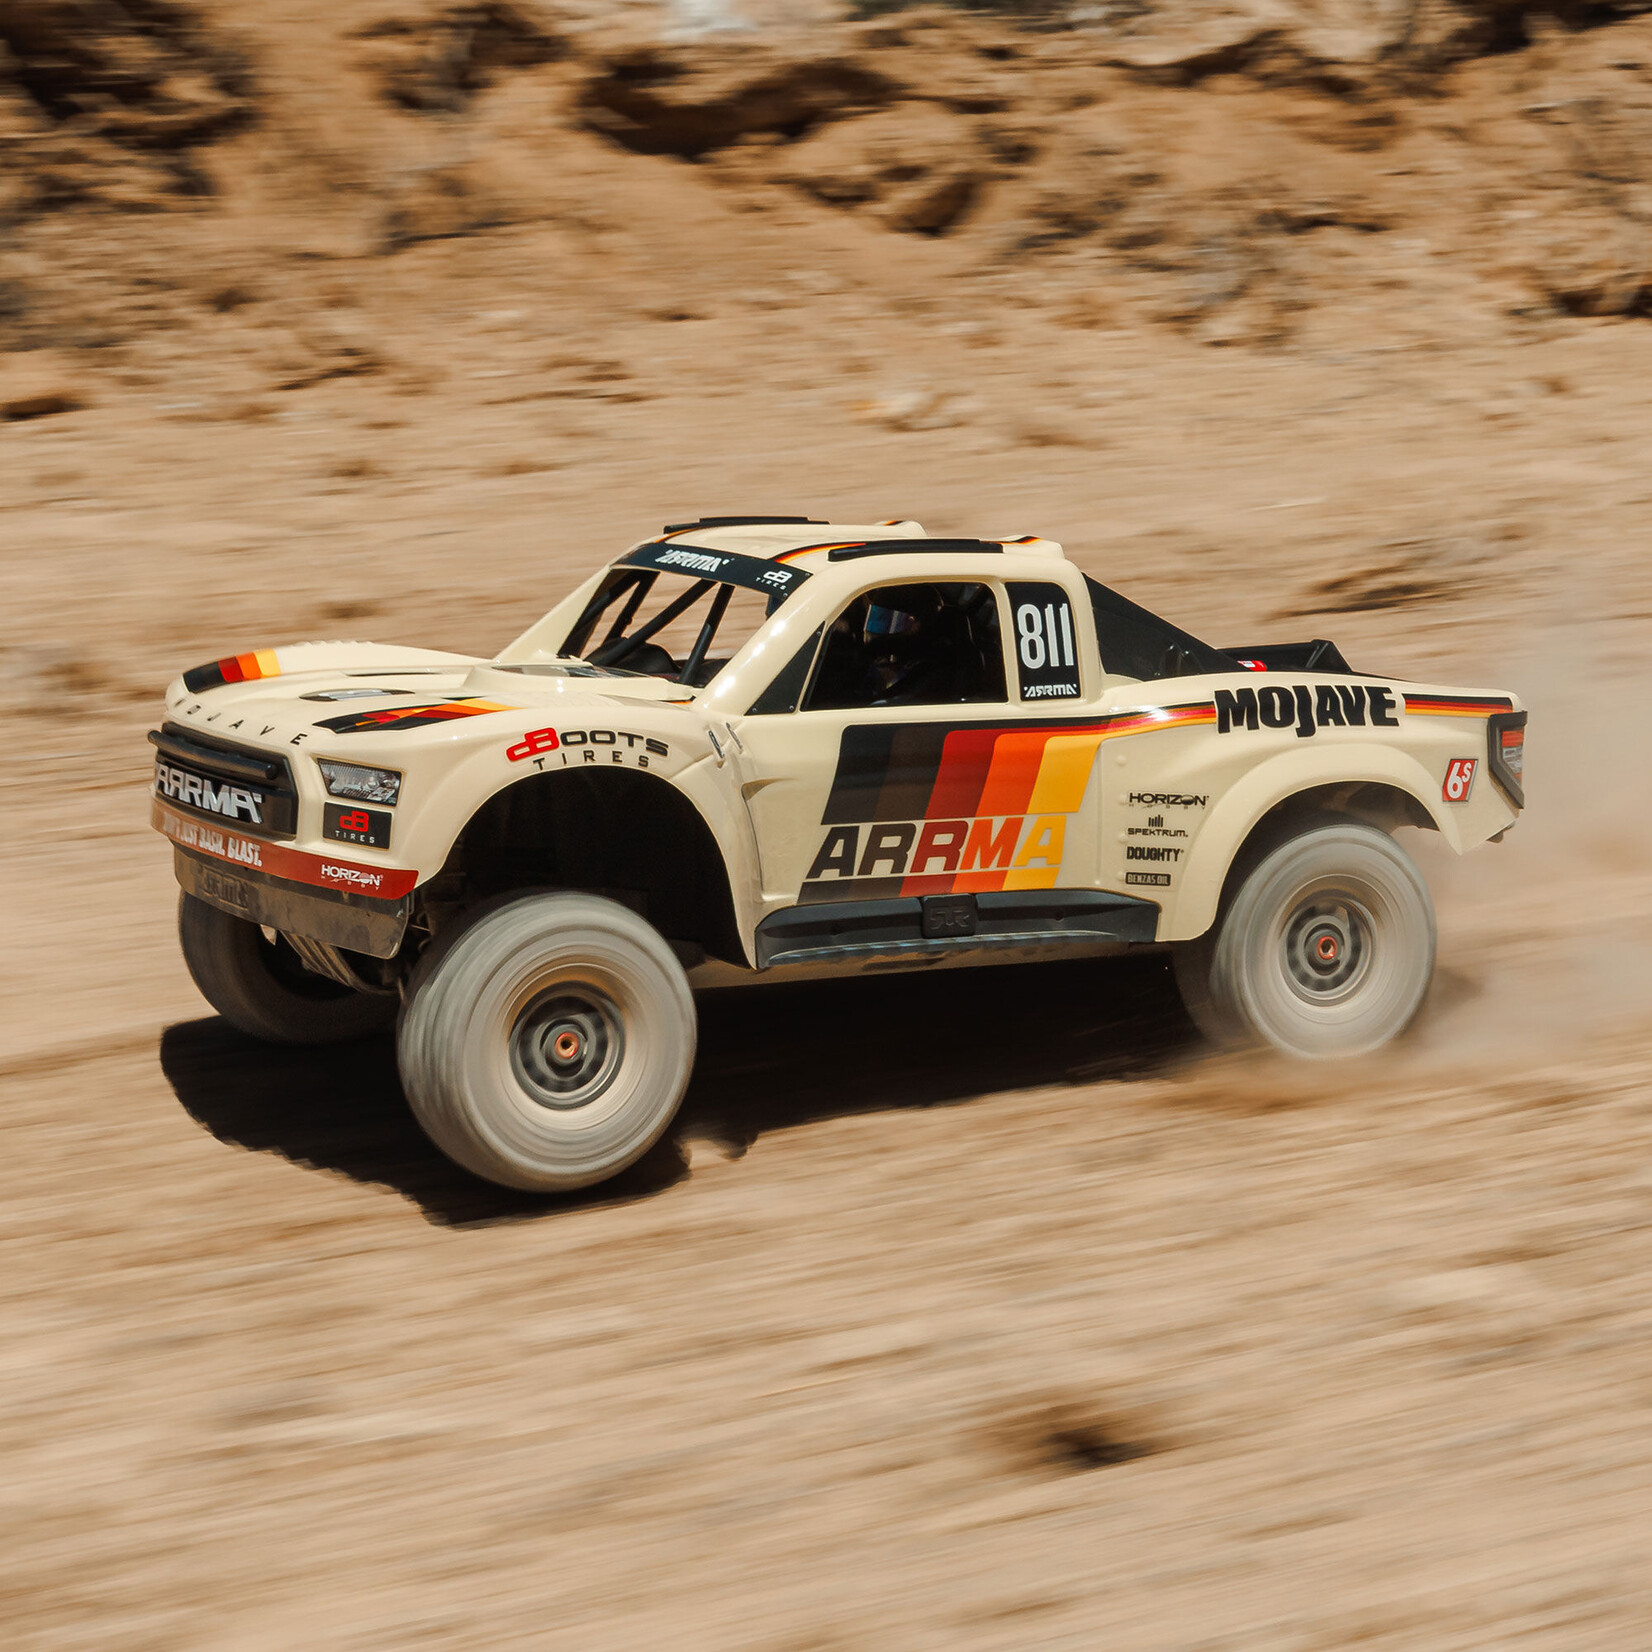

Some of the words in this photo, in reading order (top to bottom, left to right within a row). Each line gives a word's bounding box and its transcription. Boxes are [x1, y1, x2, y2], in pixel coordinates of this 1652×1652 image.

[1017, 603, 1074, 669] 811
[1214, 685, 1399, 737] MOJAVE
[533, 750, 649, 771] TIRES
[1129, 793, 1206, 806] HORIZON
[335, 830, 375, 844] TIRES
[805, 815, 1067, 879] ARRMA
[1127, 846, 1181, 862] DOUGHTY
[321, 864, 381, 886] HORIZON
